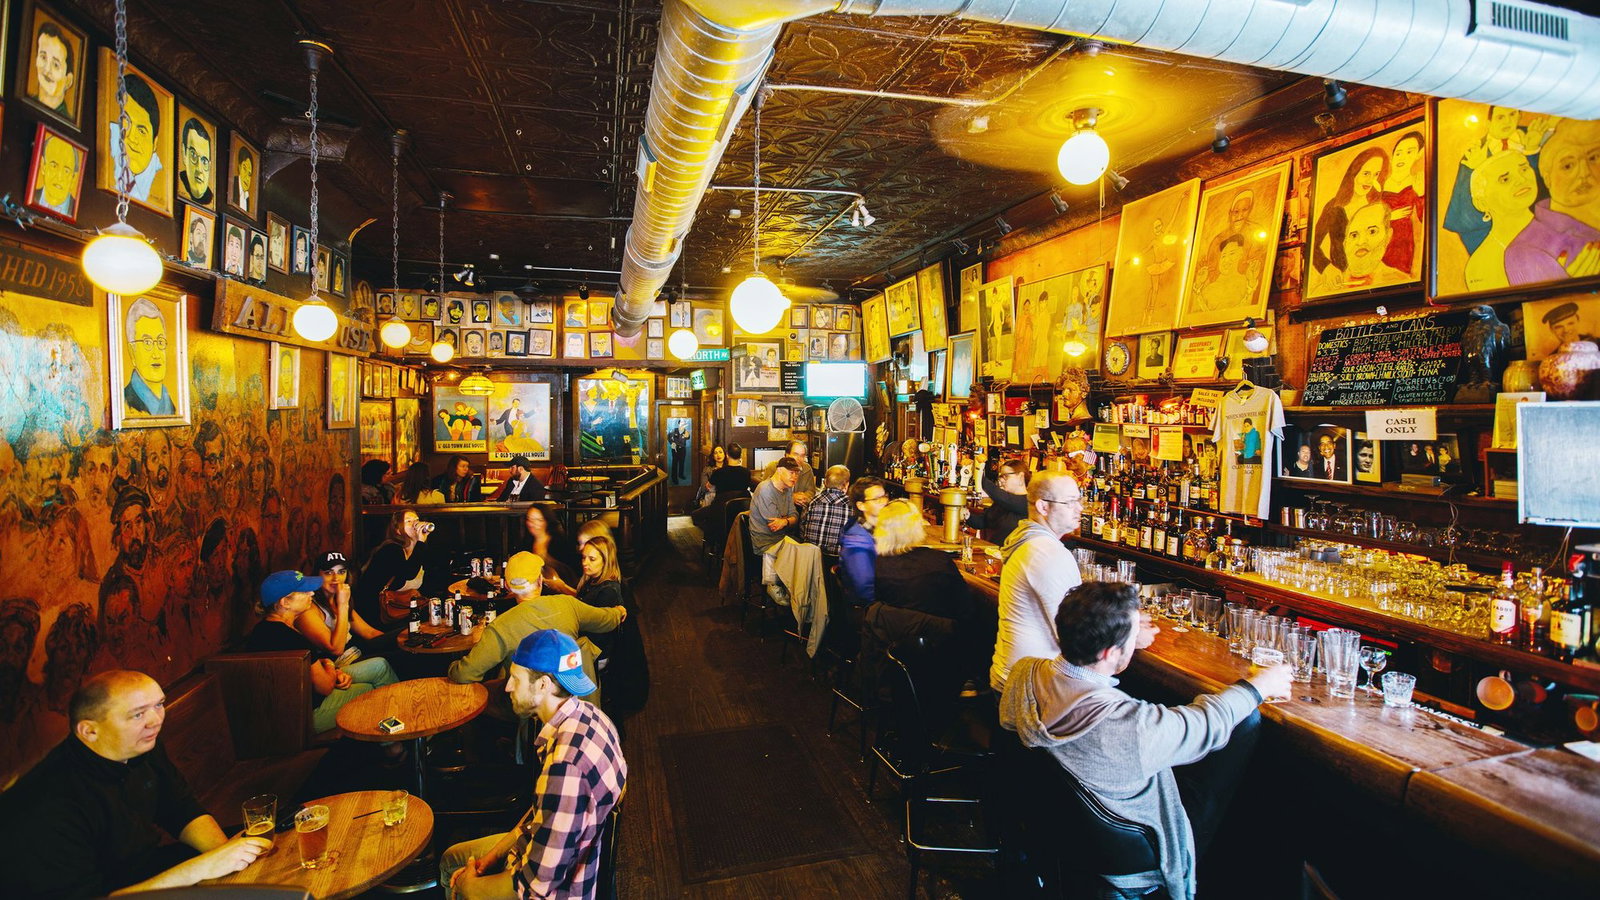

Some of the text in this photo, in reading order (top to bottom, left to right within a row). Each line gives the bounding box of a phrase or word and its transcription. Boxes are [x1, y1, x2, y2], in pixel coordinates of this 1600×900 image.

[48, 265, 86, 297] 1958
[1335, 323, 1384, 340] BOTTLES
[1401, 315, 1436, 332] CANS
[1353, 381, 1370, 391] HARD
[1386, 417, 1416, 425] CASH
[1385, 426, 1417, 434] ONLY
[327, 552, 346, 561] ATL
